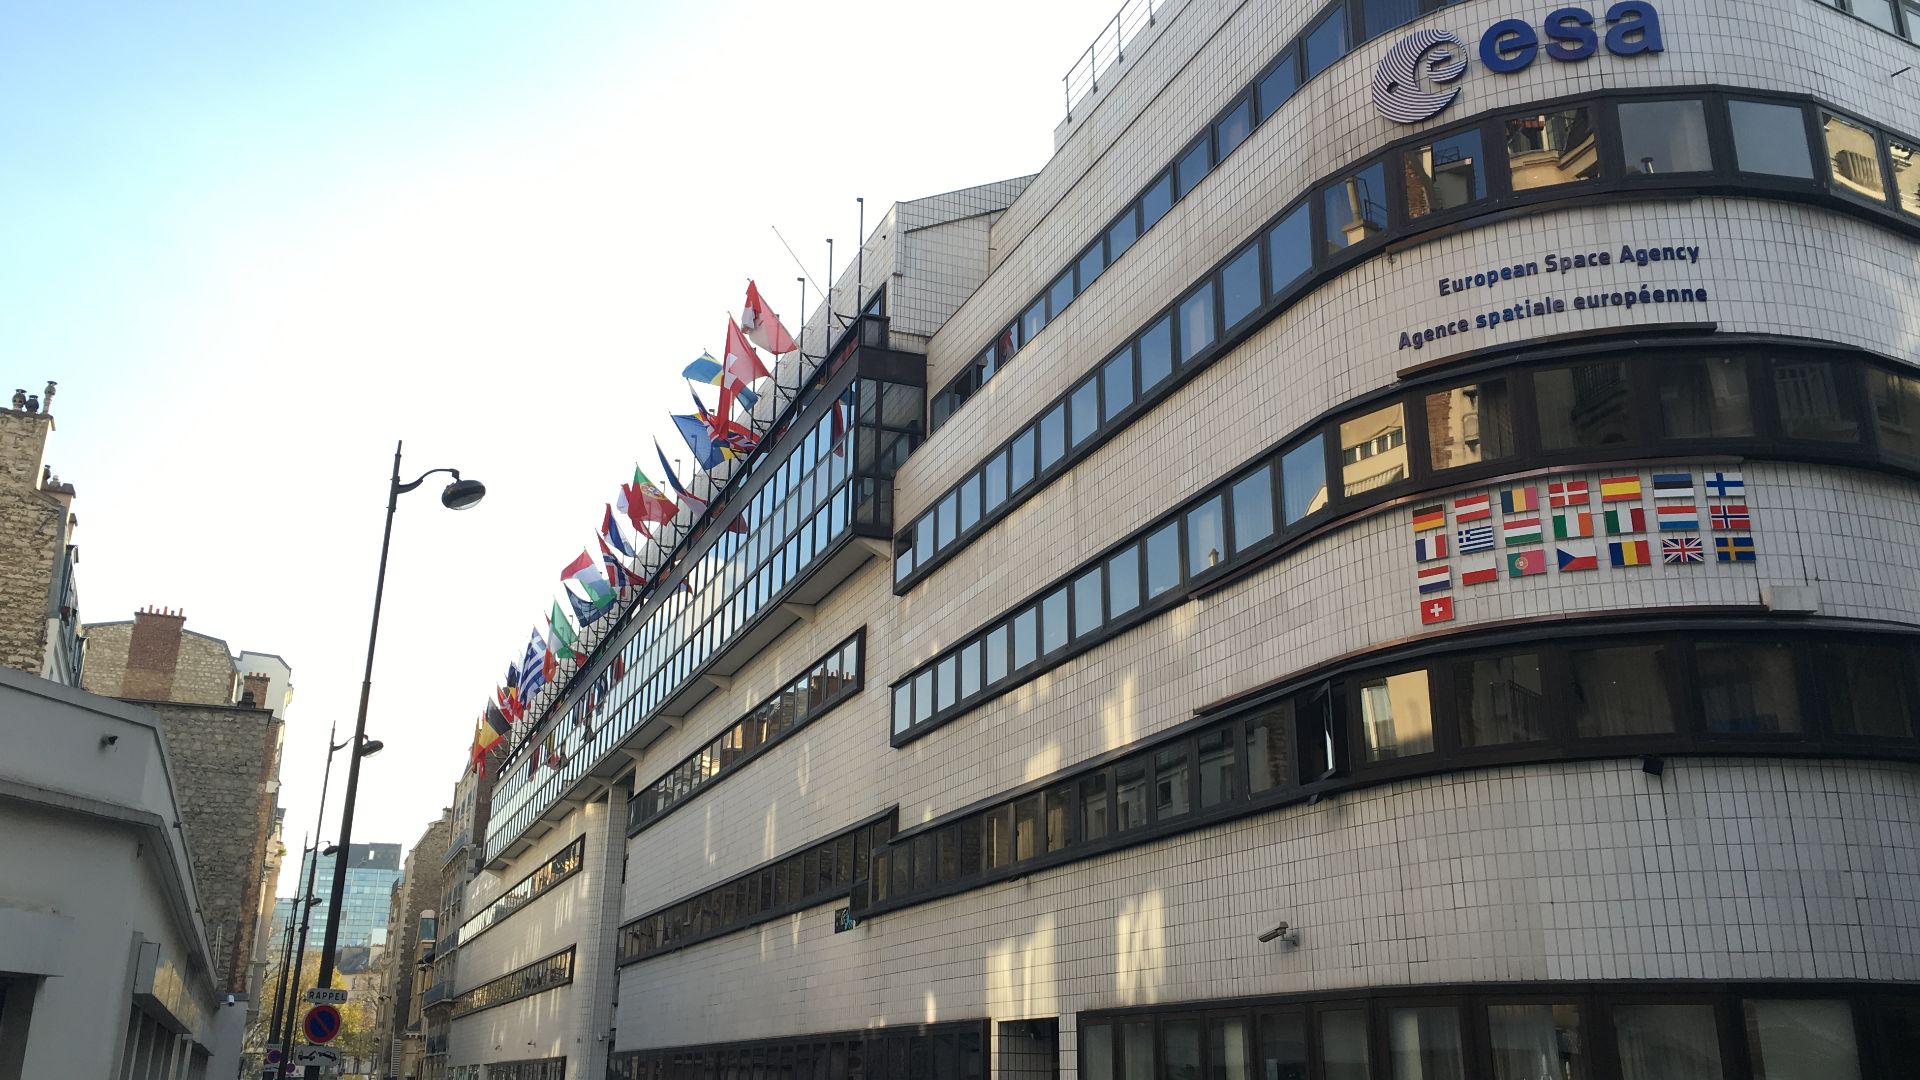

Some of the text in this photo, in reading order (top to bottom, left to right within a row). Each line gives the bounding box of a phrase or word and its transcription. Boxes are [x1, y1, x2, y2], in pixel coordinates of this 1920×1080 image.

[1479, 0, 1664, 74] esa
[1438, 244, 1700, 296] European Space Agency
[1398, 283, 1708, 350] Agence spatiale européenne
[308, 991, 346, 1001] RAPPEL
